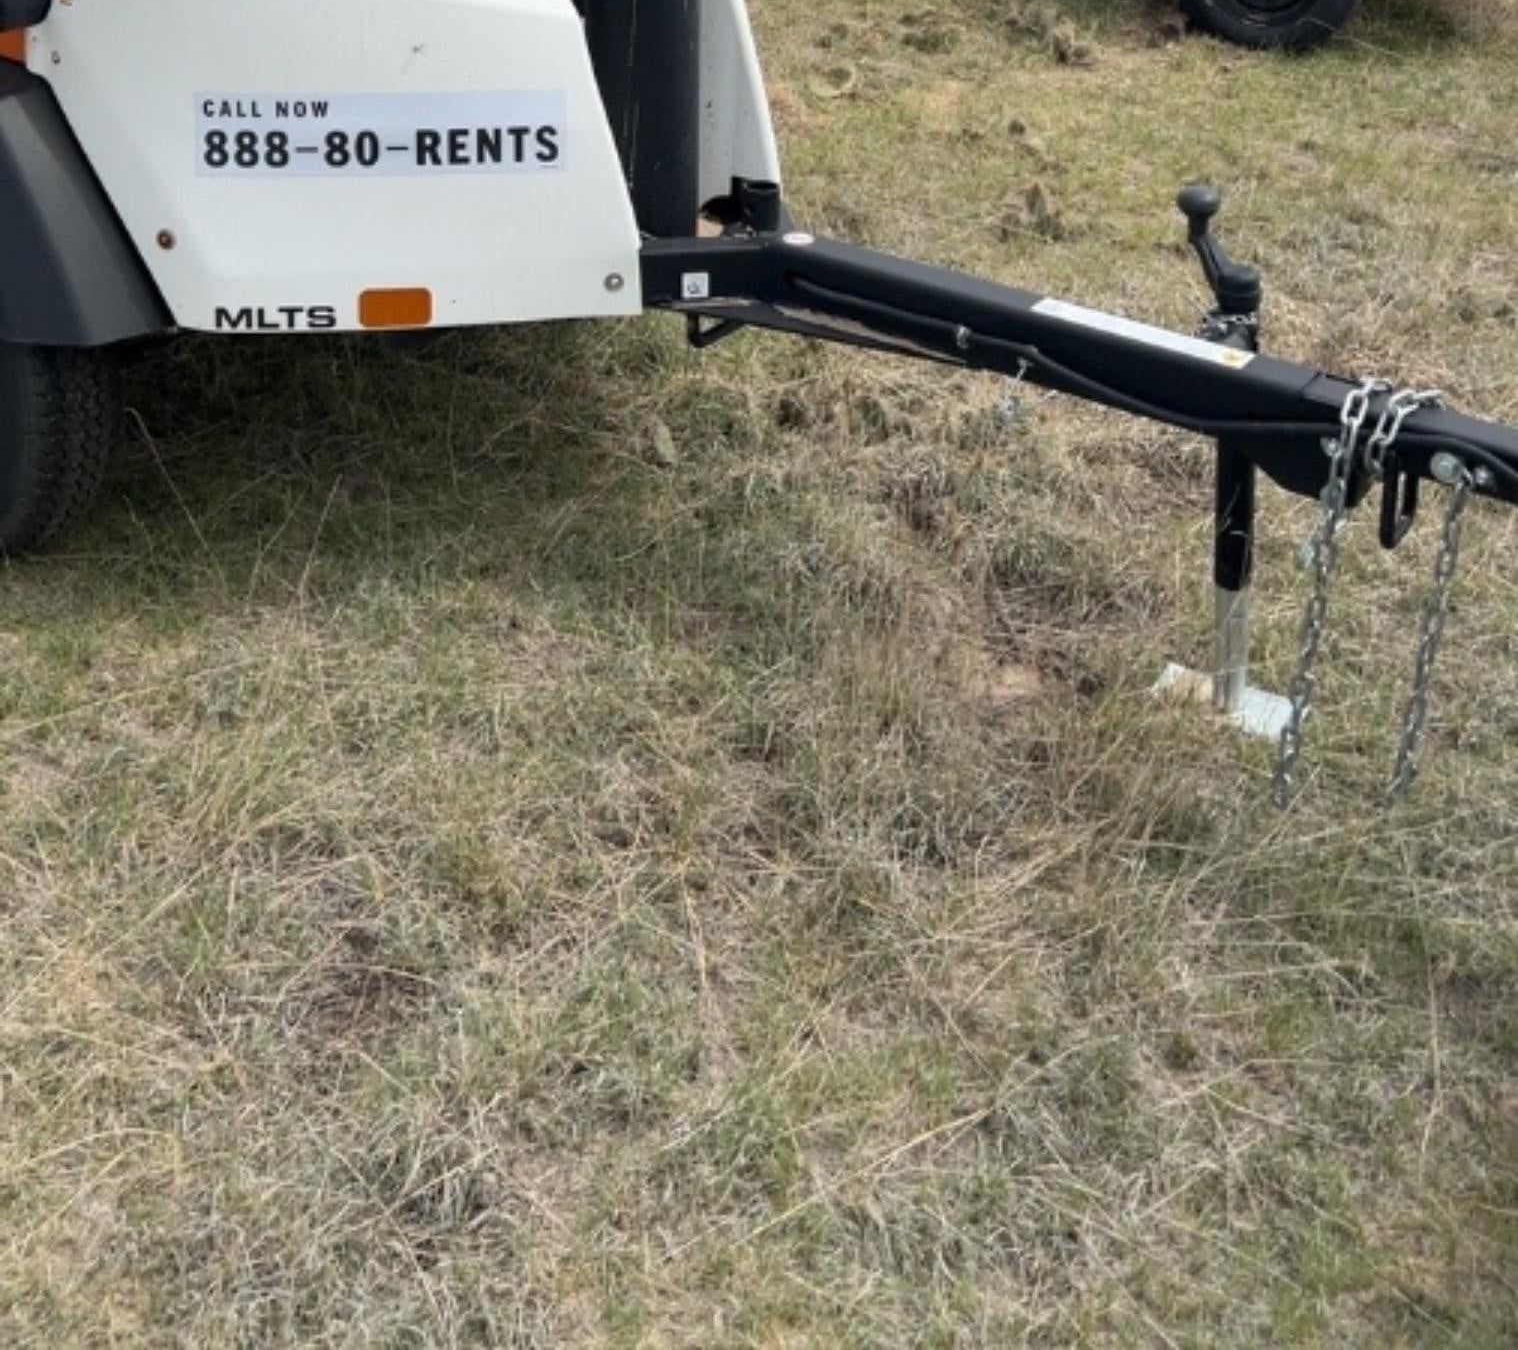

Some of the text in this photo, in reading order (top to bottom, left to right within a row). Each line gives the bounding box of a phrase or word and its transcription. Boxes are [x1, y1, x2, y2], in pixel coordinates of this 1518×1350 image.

[203, 99, 330, 118] CALL NOW
[204, 125, 560, 169] 888-80-RENTS
[215, 305, 336, 328] MLTS
